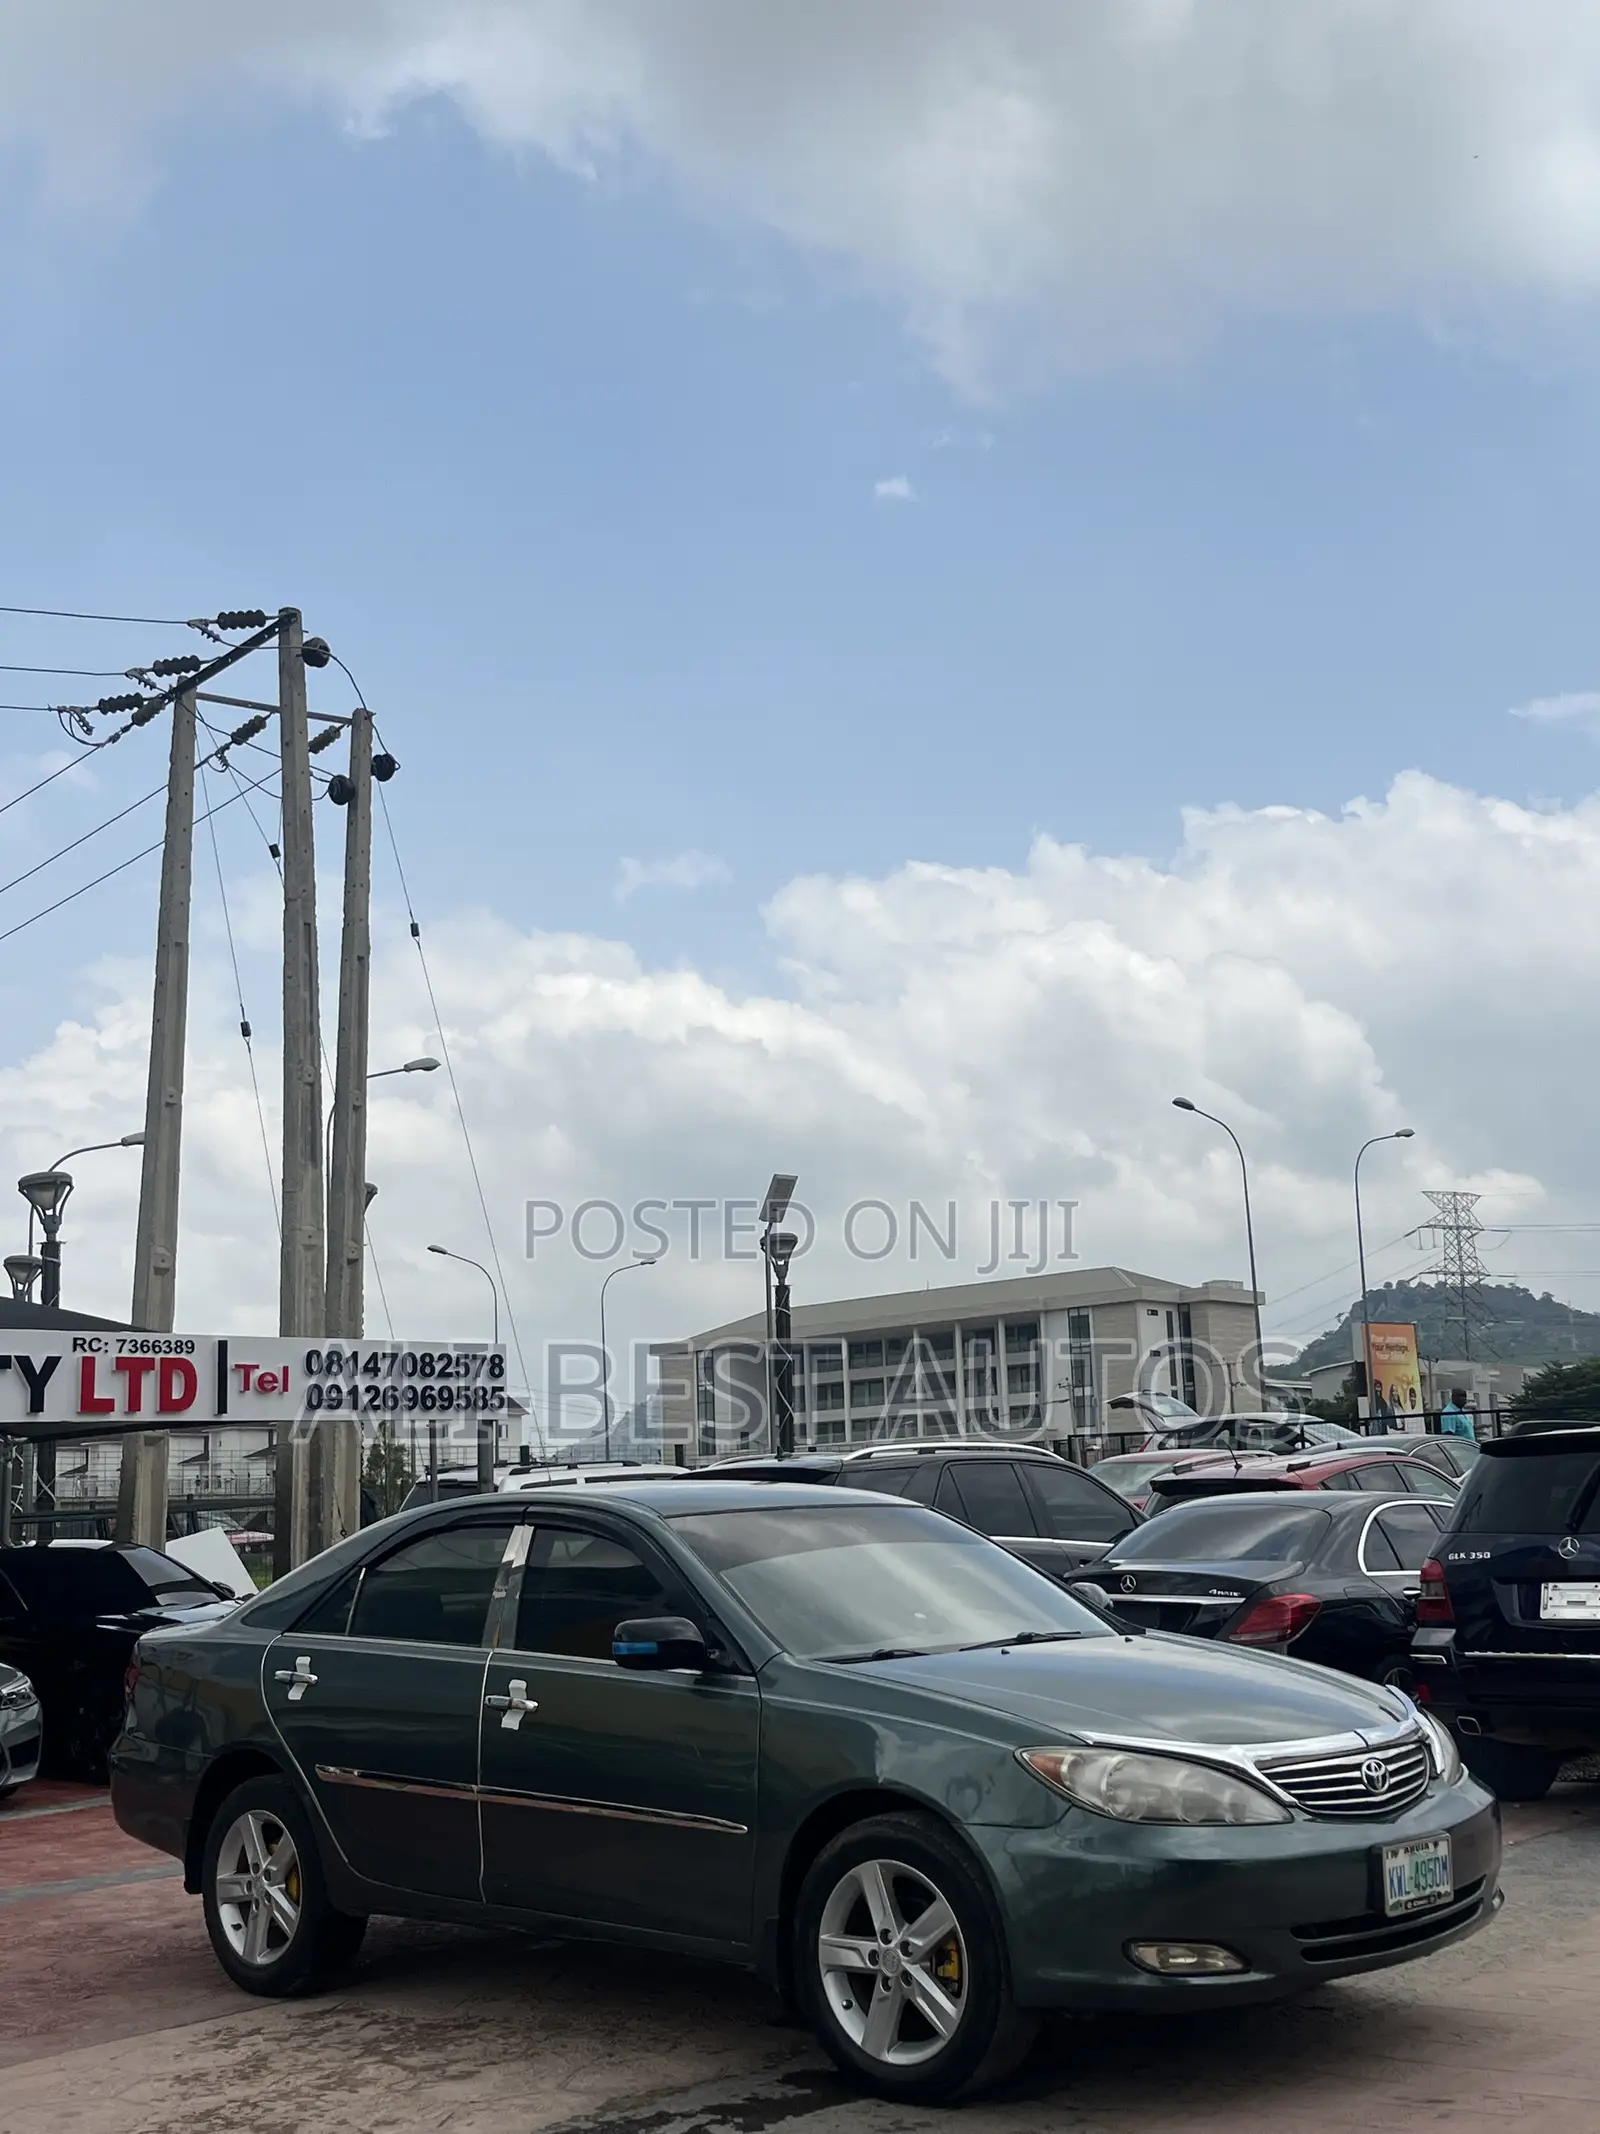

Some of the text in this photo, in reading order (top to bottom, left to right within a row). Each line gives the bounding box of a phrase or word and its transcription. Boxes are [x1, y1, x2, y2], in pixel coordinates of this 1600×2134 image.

[72, 1337, 195, 1354] RC: 7366389
[0, 1355, 198, 1413] Y LTD
[235, 1349, 505, 1394] Tel 08147082578
[305, 1383, 506, 1411] 09126969585
[1448, 1551, 1491, 1560] GLK 350
